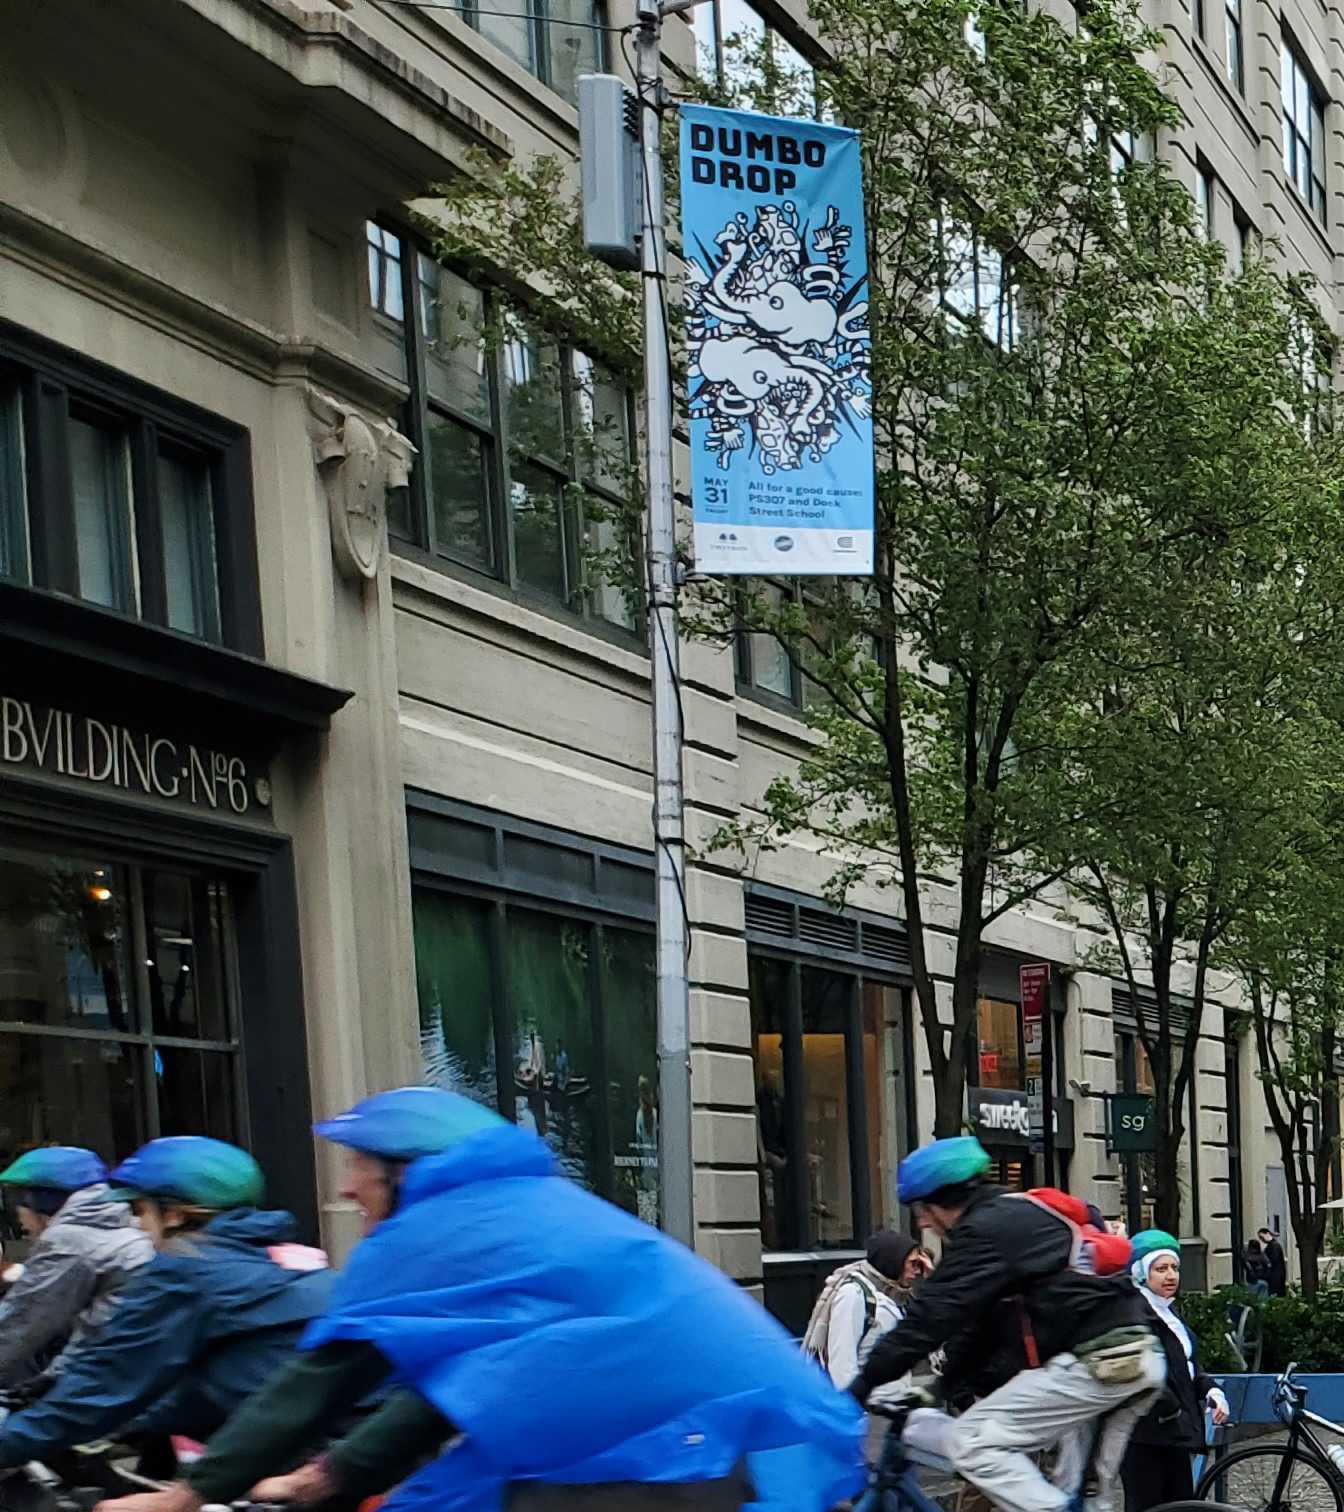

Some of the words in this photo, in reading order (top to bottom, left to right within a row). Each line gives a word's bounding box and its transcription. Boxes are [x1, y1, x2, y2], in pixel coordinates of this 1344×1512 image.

[691, 124, 826, 167] DUMBO
[692, 156, 796, 195] DROP
[704, 477, 729, 486] MAY
[705, 487, 728, 504] 31
[796, 487, 823, 496] good
[788, 497, 809, 506] and
[1122, 1115, 1145, 1131] sg
